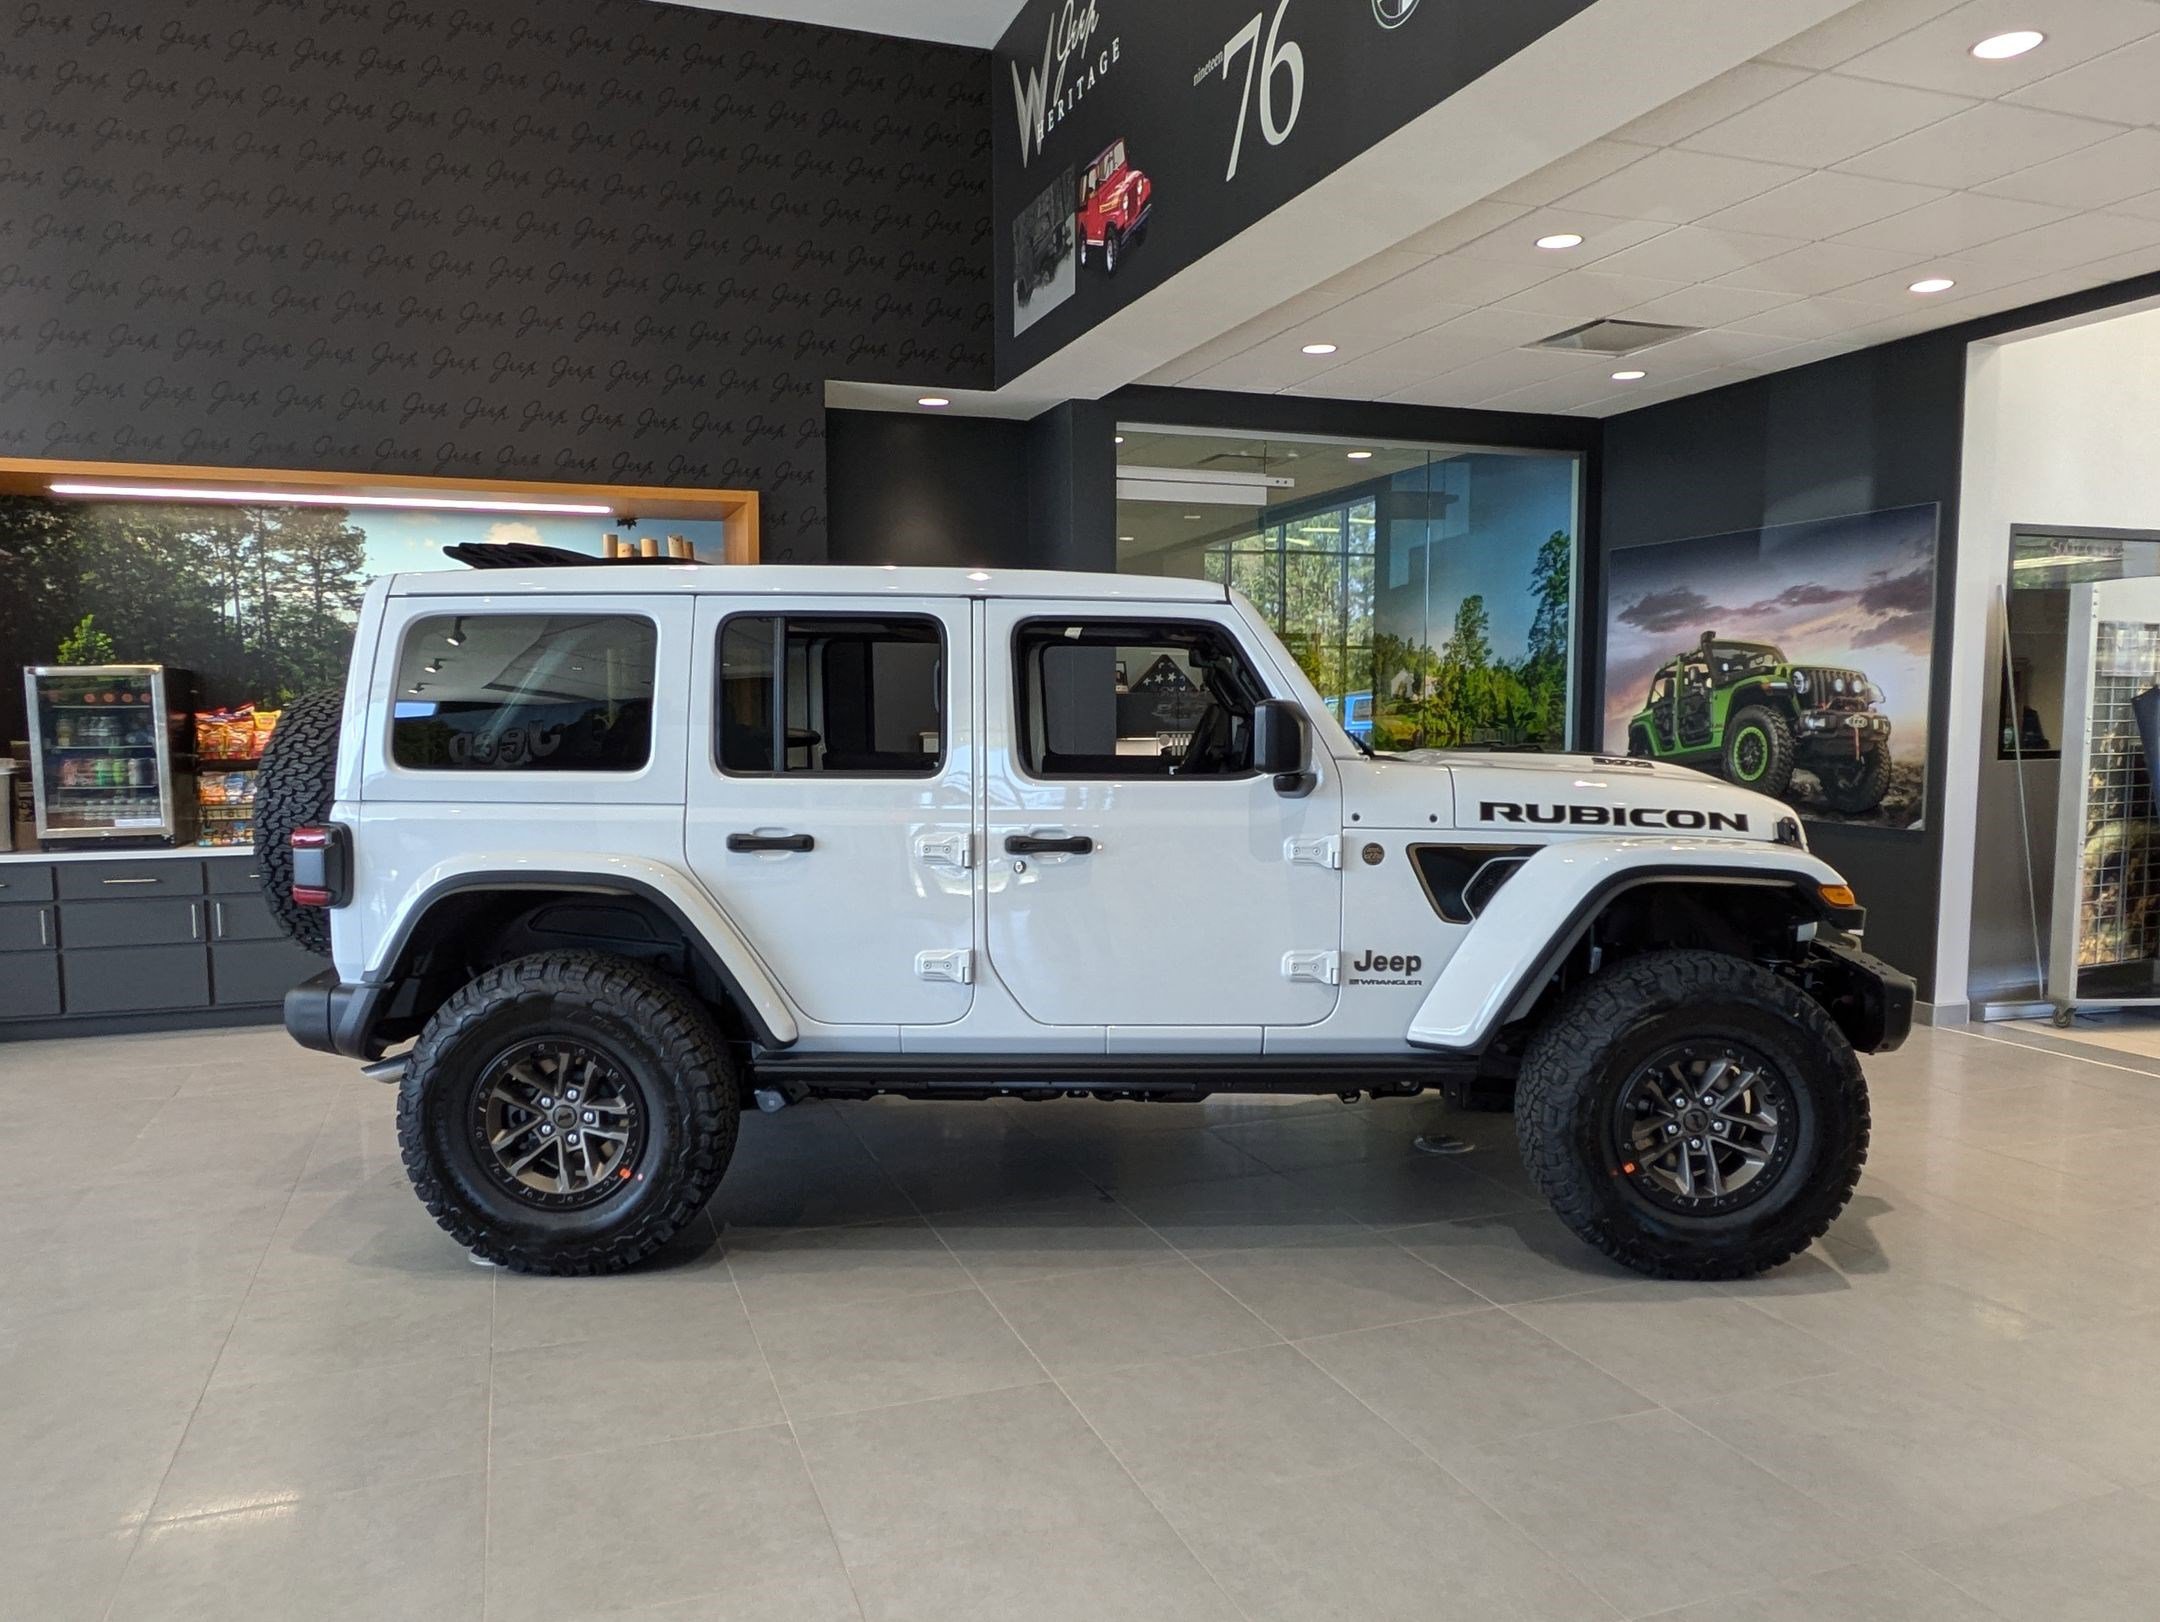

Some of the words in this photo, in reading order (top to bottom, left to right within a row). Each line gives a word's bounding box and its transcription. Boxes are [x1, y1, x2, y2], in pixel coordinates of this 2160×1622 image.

[1053, 0, 1099, 106] Jeep
[1193, 50, 1224, 87] nineteen
[1036, 37, 1120, 143] HERITAGE
[1222, 0, 1304, 182] 76
[1480, 801, 1749, 832] RUBICON
[1354, 950, 1422, 976] Jeep
